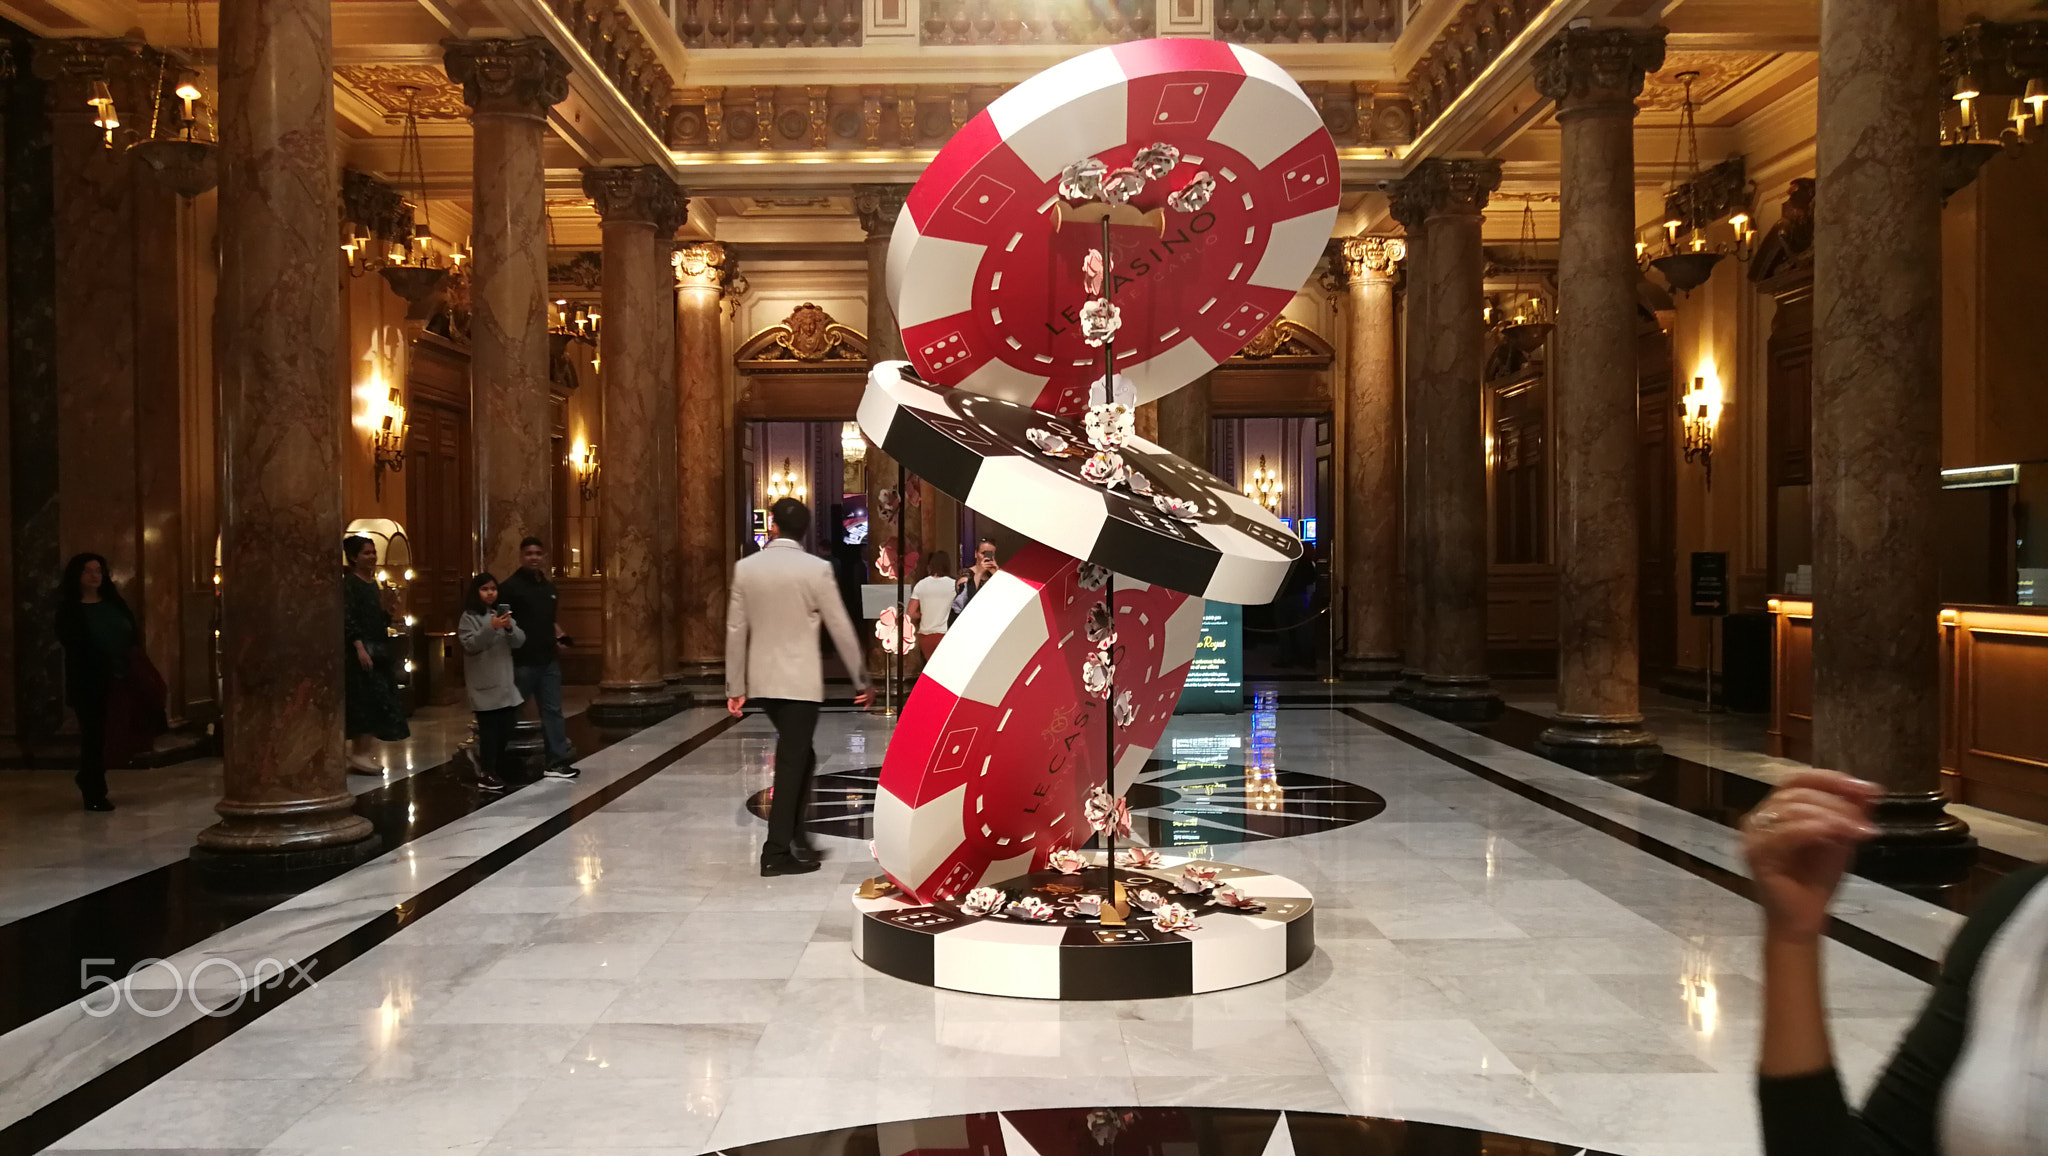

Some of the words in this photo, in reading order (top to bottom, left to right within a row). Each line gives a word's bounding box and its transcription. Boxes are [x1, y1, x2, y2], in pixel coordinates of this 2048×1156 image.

[1045, 305, 1080, 335] LE
[1086, 212, 1216, 304] ASINO
[1024, 783, 1050, 814] LE
[1049, 645, 1126, 775] CASIO
